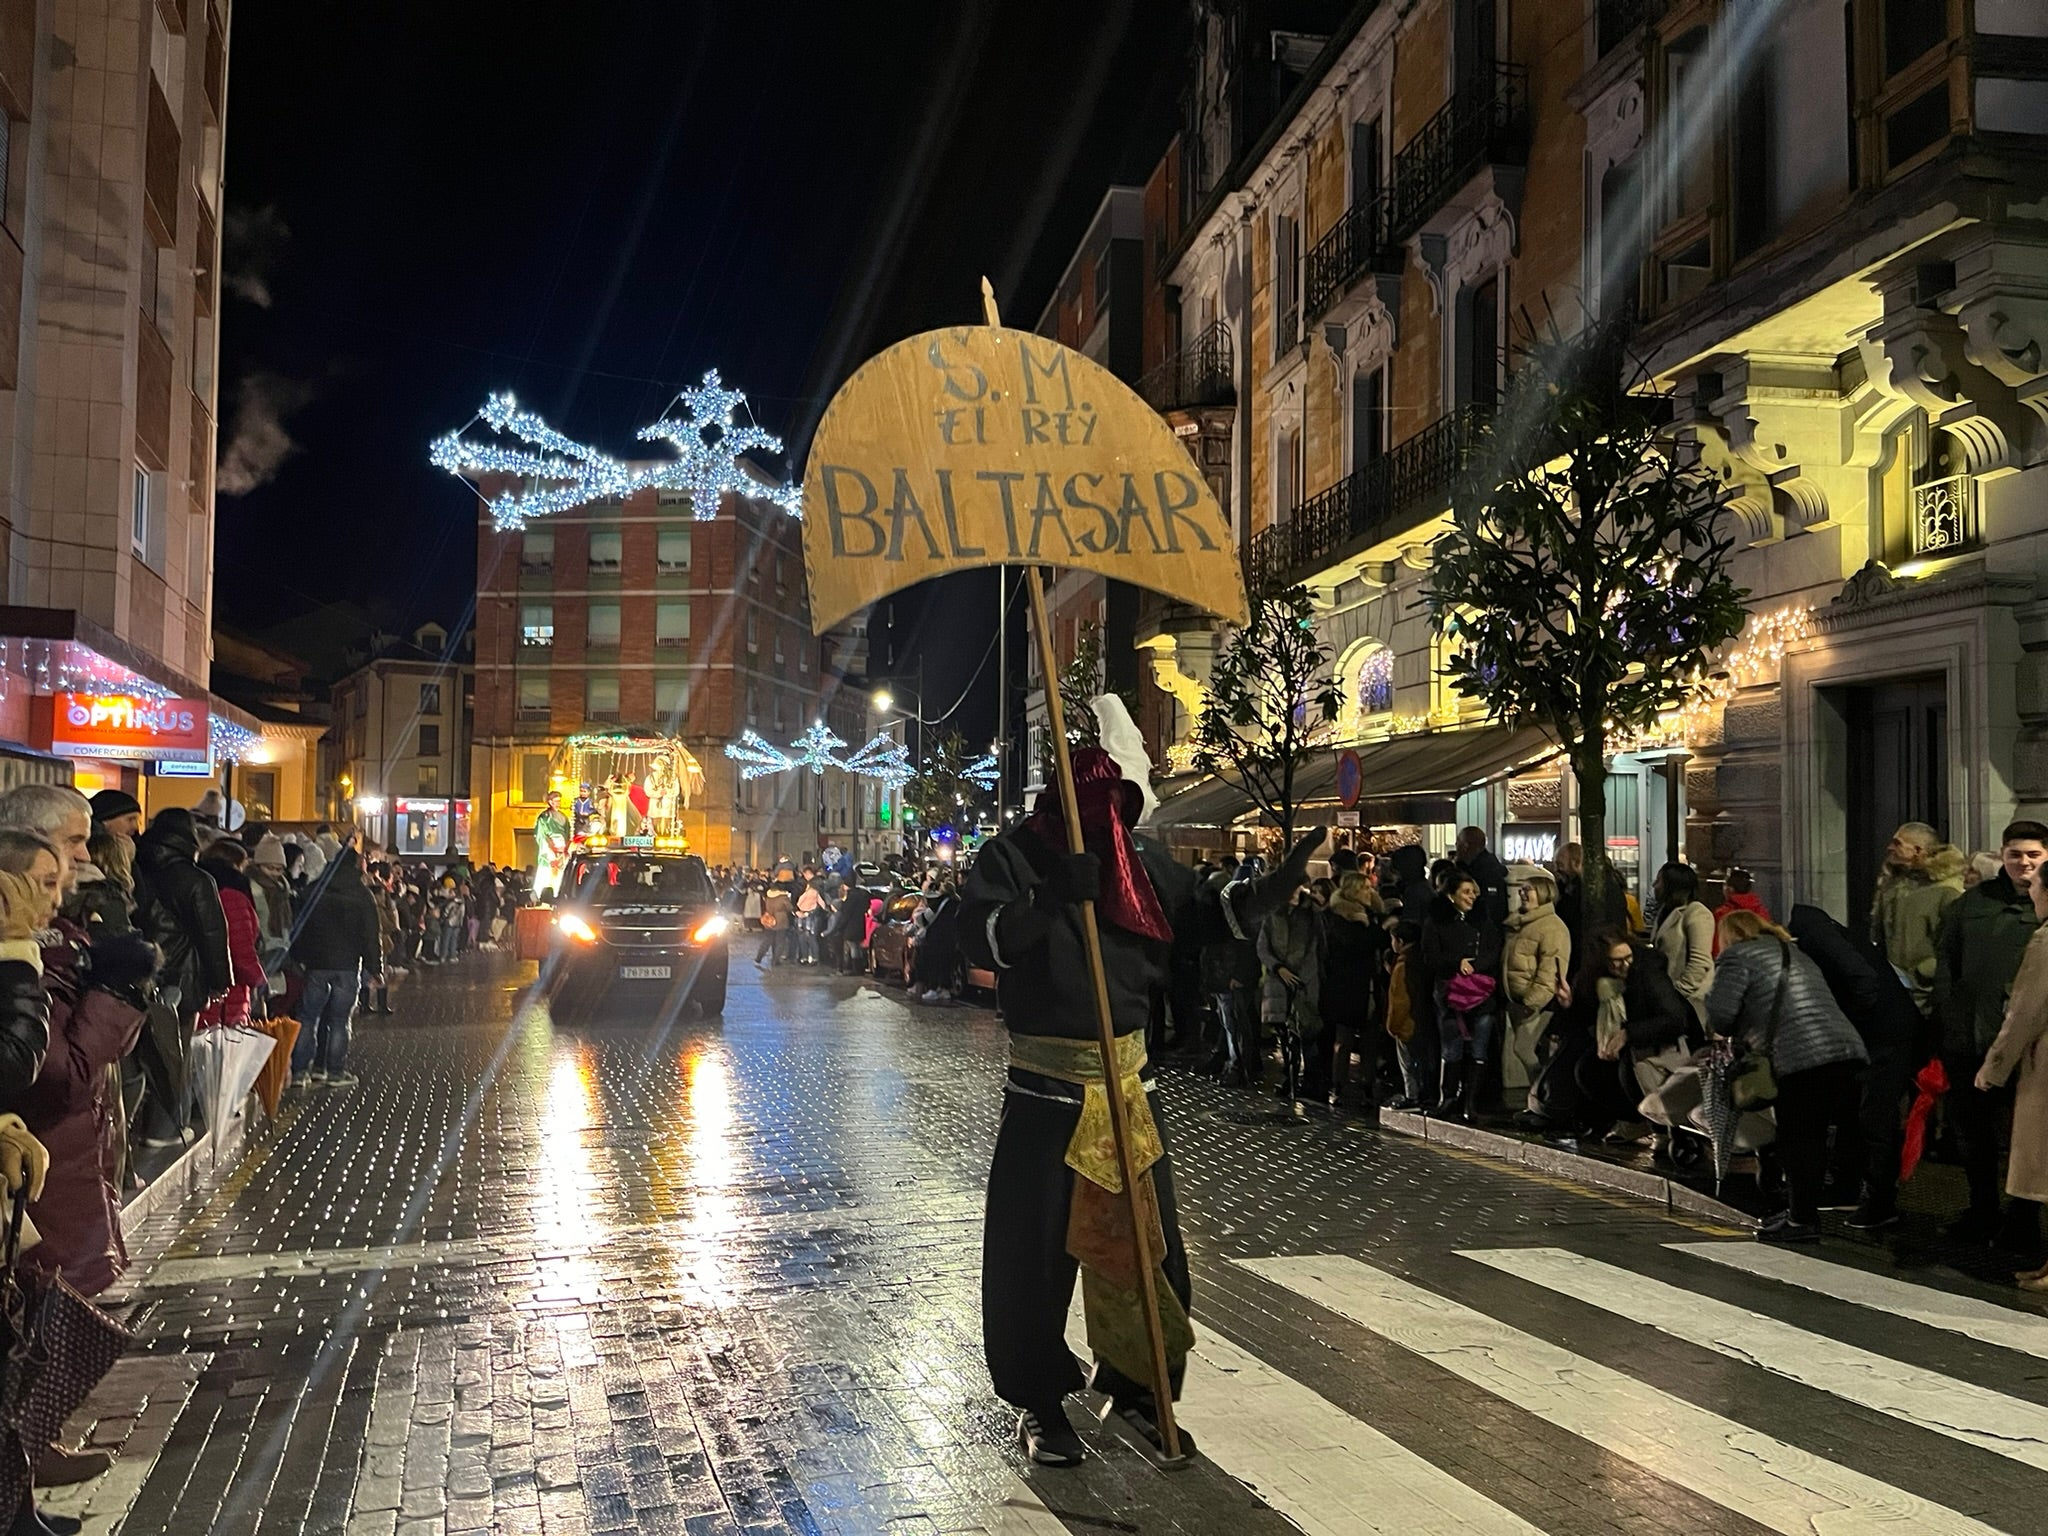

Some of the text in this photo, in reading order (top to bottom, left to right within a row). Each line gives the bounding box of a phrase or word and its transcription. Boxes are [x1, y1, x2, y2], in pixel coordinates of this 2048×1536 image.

[927, 336, 1092, 412] S. M.
[1021, 406, 1098, 446] REY
[820, 464, 1220, 561] BALTASAR
[68, 704, 194, 731] OPTIMUS
[73, 746, 130, 758] COMERCIAL
[624, 838, 653, 846] ESPECIAL
[602, 907, 680, 917] ROXU
